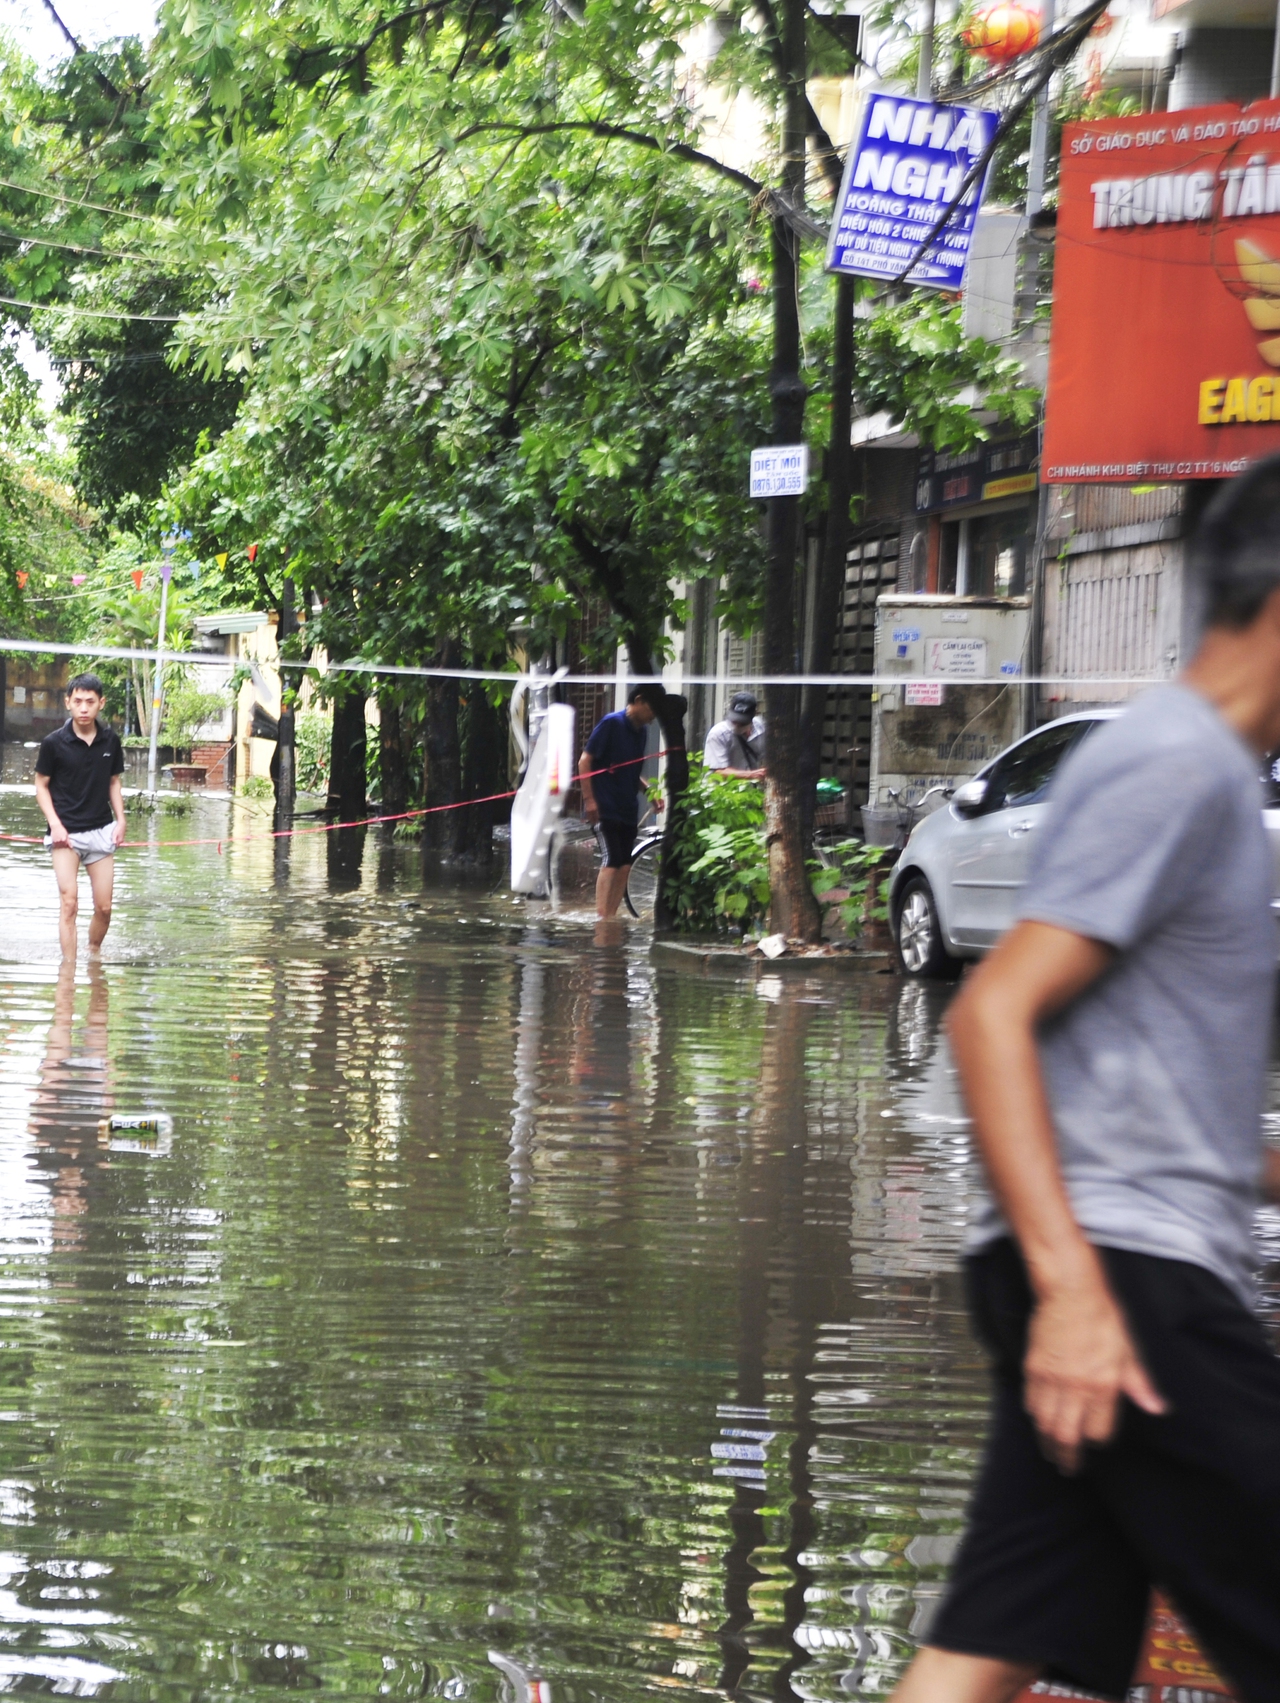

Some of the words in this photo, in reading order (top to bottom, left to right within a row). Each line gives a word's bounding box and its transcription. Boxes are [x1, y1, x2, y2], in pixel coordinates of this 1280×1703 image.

[867, 102, 984, 156] NHÀ
[1071, 133, 1092, 155] SỞ
[1096, 132, 1132, 151] GIÁO
[1171, 126, 1189, 143] VÀ
[1194, 121, 1226, 140] ĐÀO
[846, 194, 904, 216] HOÀNG
[964, 214, 971, 229] 1
[1091, 171, 1214, 229] TRUNG
[891, 224, 902, 237] 2
[856, 257, 870, 267] 141
[1047, 466, 1063, 478] CHI
[1064, 463, 1100, 477] NHÁNH
[1102, 464, 1124, 476] KHU
[1126, 461, 1149, 477] BIỆT
[1152, 462, 1174, 476] THỰ
[1176, 462, 1191, 474] C2
